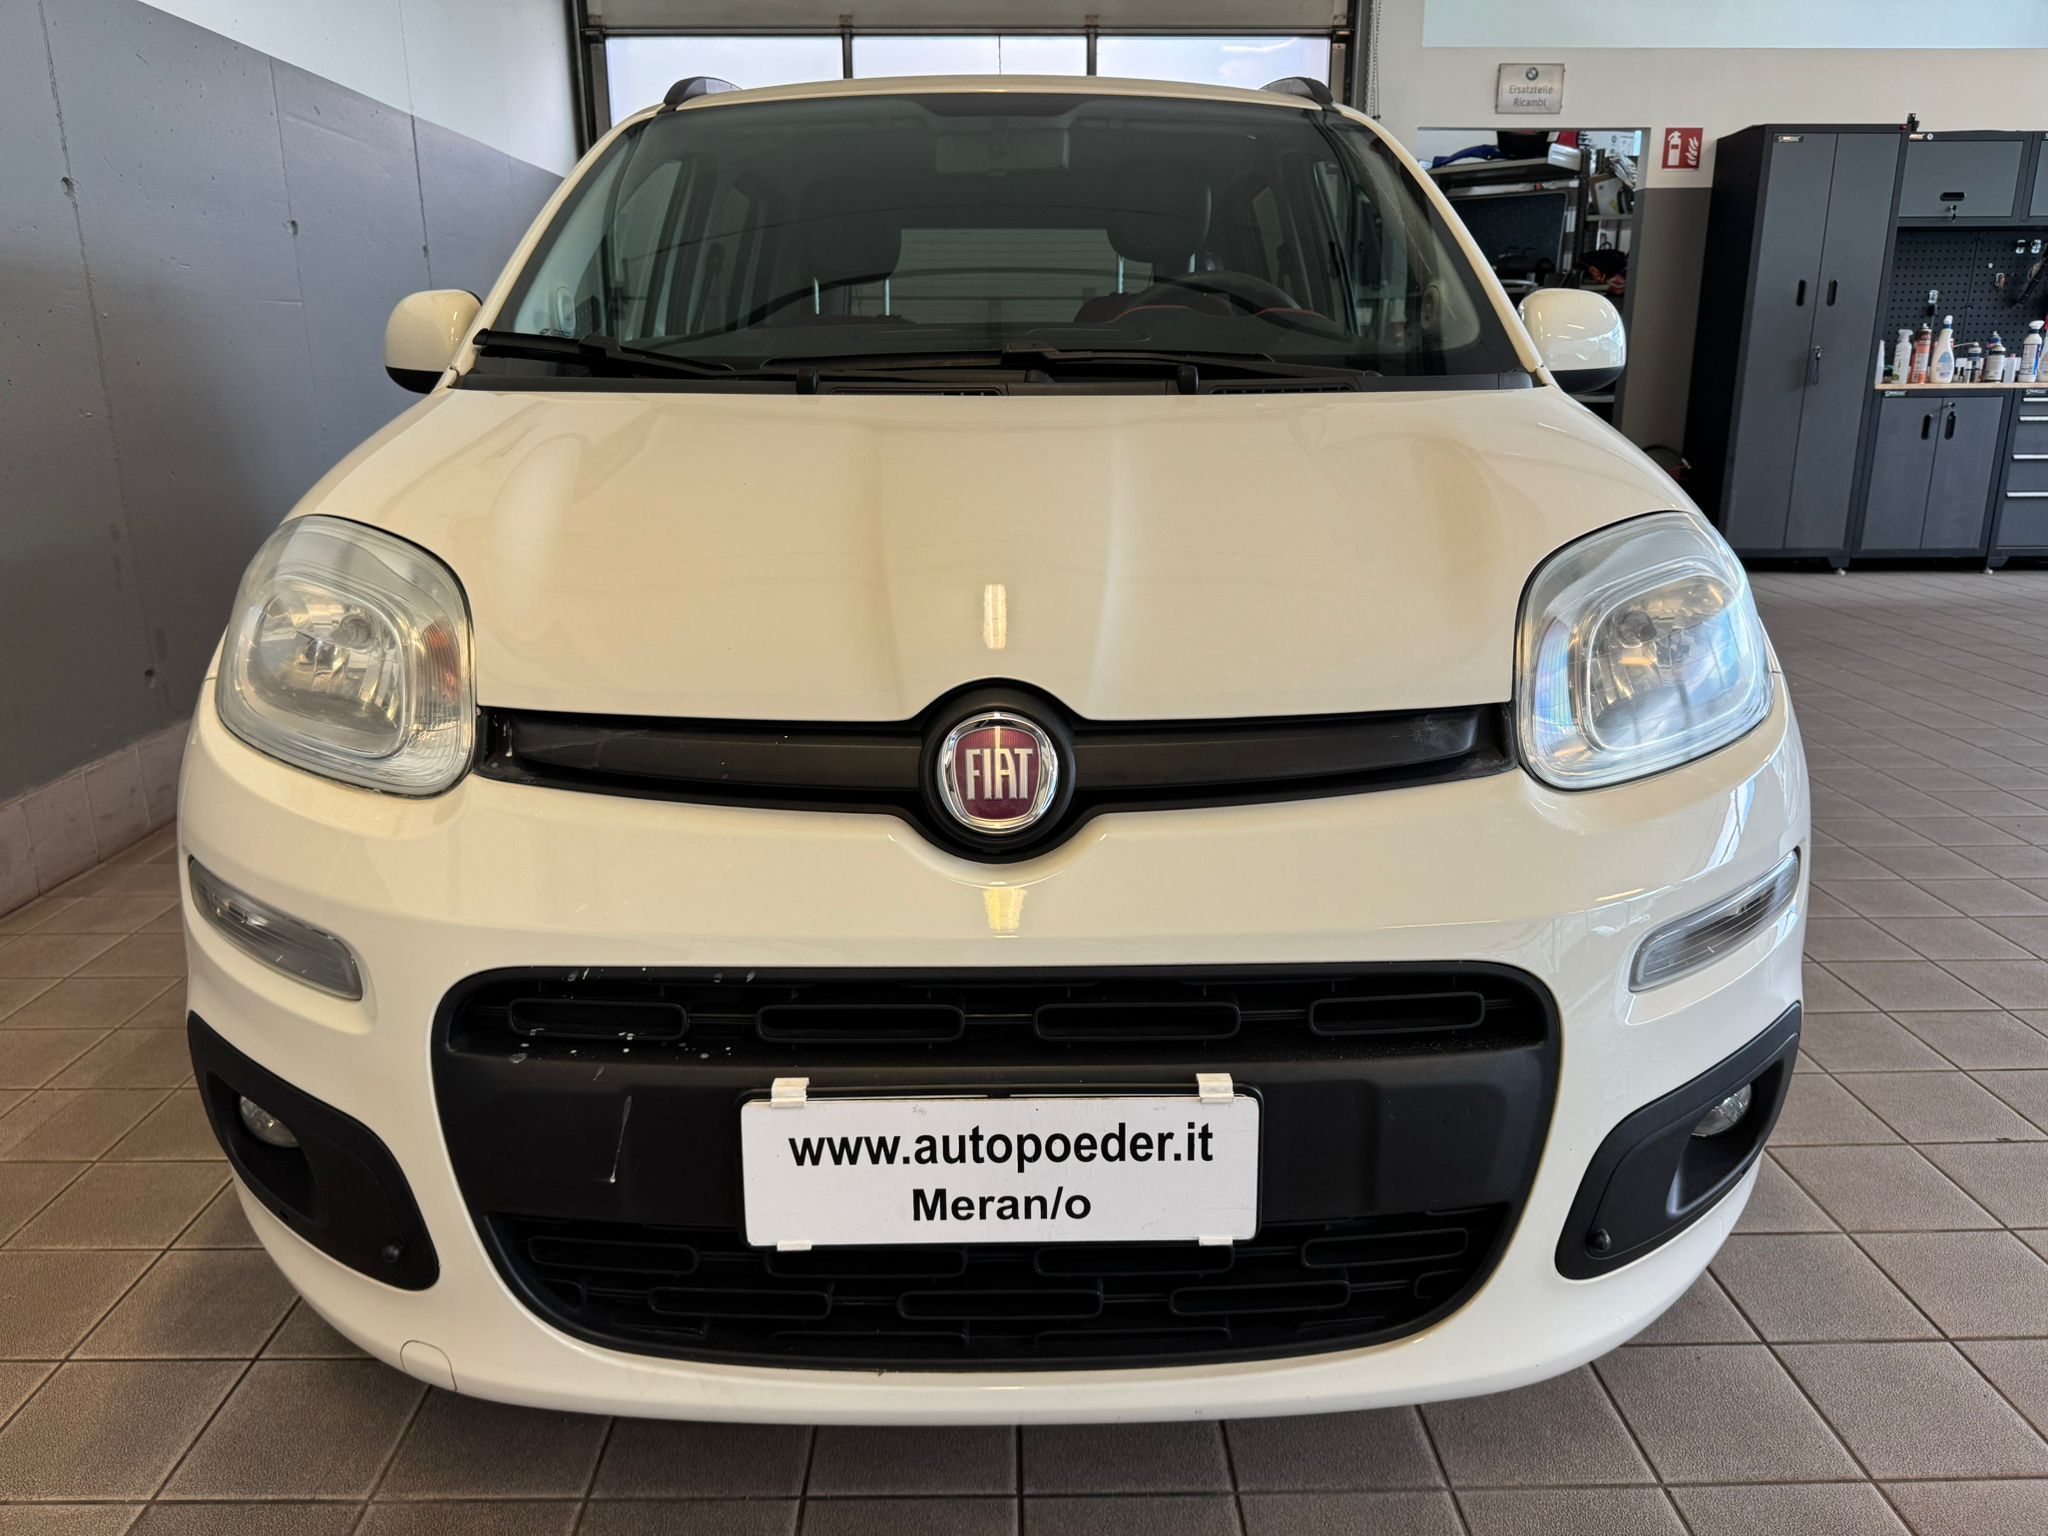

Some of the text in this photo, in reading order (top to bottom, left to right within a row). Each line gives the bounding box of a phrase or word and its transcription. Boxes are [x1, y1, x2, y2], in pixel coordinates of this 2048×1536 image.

[1508, 84, 1554, 95] Ersatzteile
[1513, 97, 1546, 108] Ricambi
[964, 747, 1034, 801] FIAT
[788, 1121, 1214, 1174] www.autopoeder.it
[912, 1186, 1092, 1222] Meran/o
